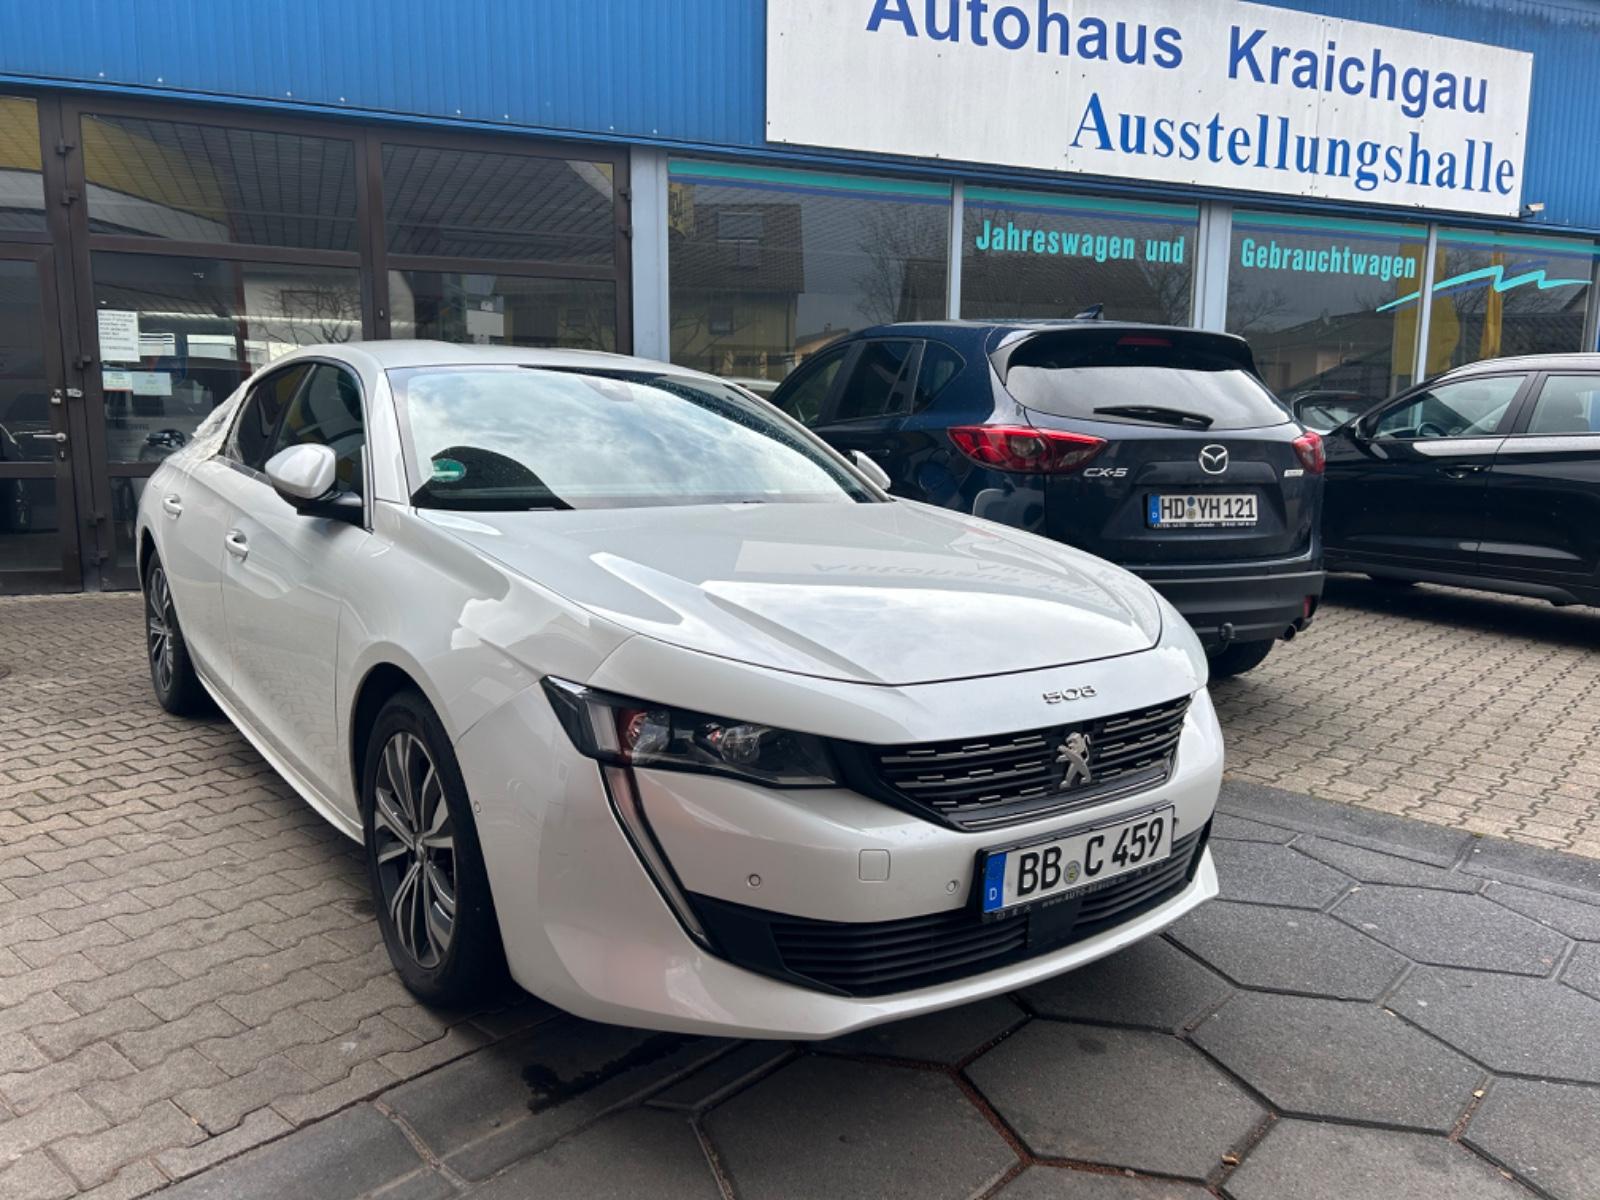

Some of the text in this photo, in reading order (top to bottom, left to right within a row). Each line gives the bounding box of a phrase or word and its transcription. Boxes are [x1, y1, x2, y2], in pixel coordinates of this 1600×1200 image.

[866, 0, 1488, 118] Autohaus Kraichgau
[1070, 93, 1515, 194] Ausstellungshalle
[976, 220, 1185, 264] Jahreswagen und
[1241, 238, 1416, 282] Gebrauchtwagen
[1083, 467, 1129, 477] CX-5
[1161, 498, 1255, 519] HD YH 121
[1042, 685, 1097, 705] 508
[1017, 846, 1062, 897] BB
[1084, 834, 1105, 877] C
[1112, 817, 1164, 867] 459
[989, 888, 998, 900] D
